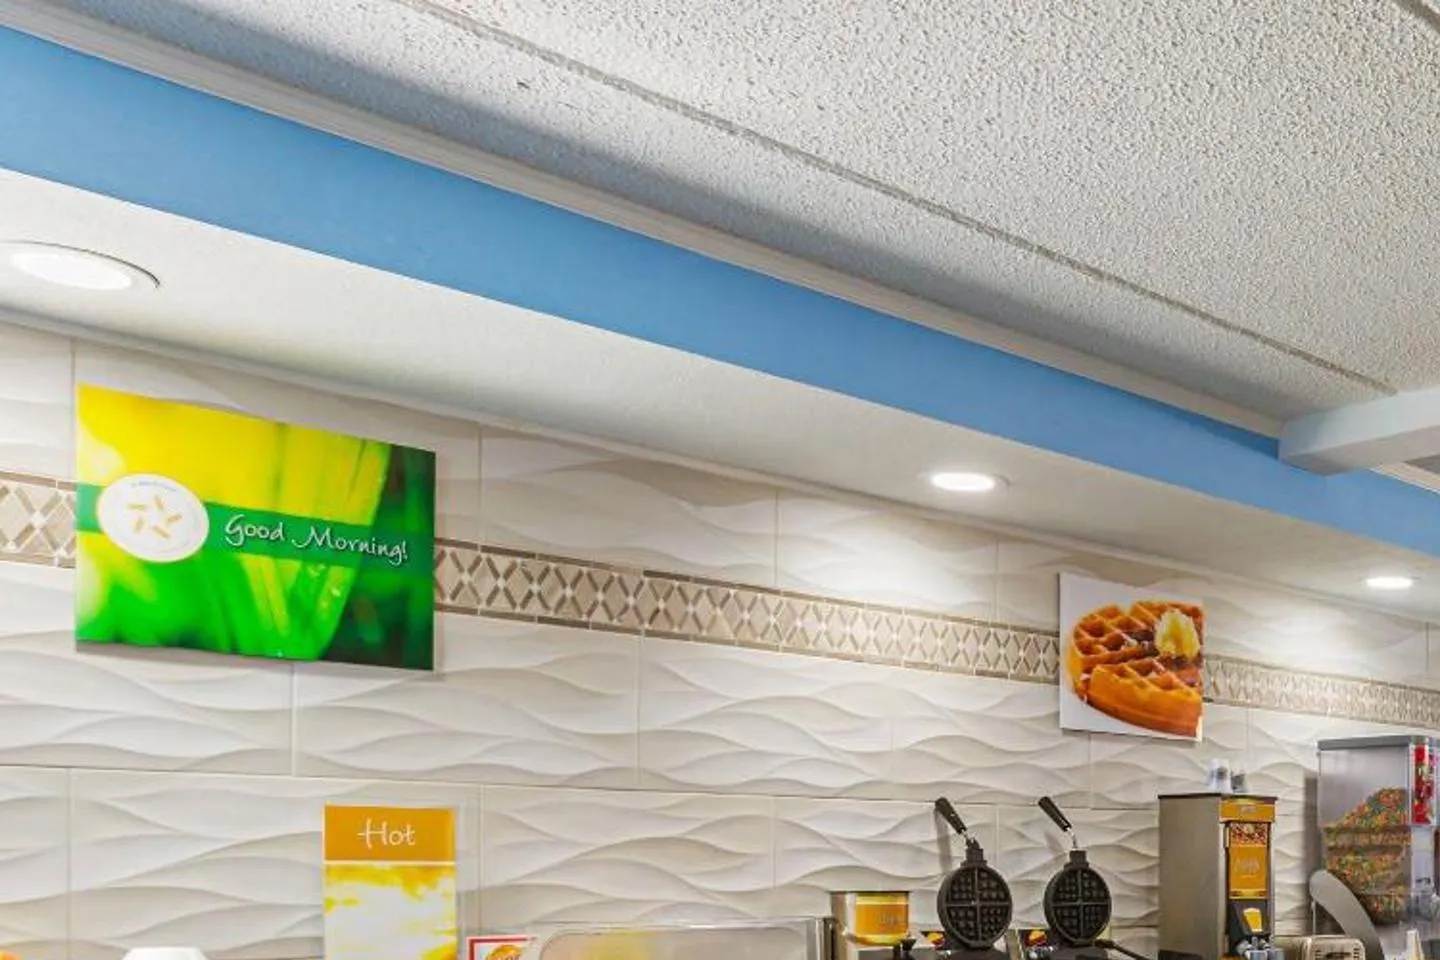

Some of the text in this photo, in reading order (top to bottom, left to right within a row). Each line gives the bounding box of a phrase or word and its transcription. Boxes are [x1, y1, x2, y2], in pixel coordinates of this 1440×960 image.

[224, 514, 409, 566] Good Morning!
[356, 817, 416, 849] Hot
